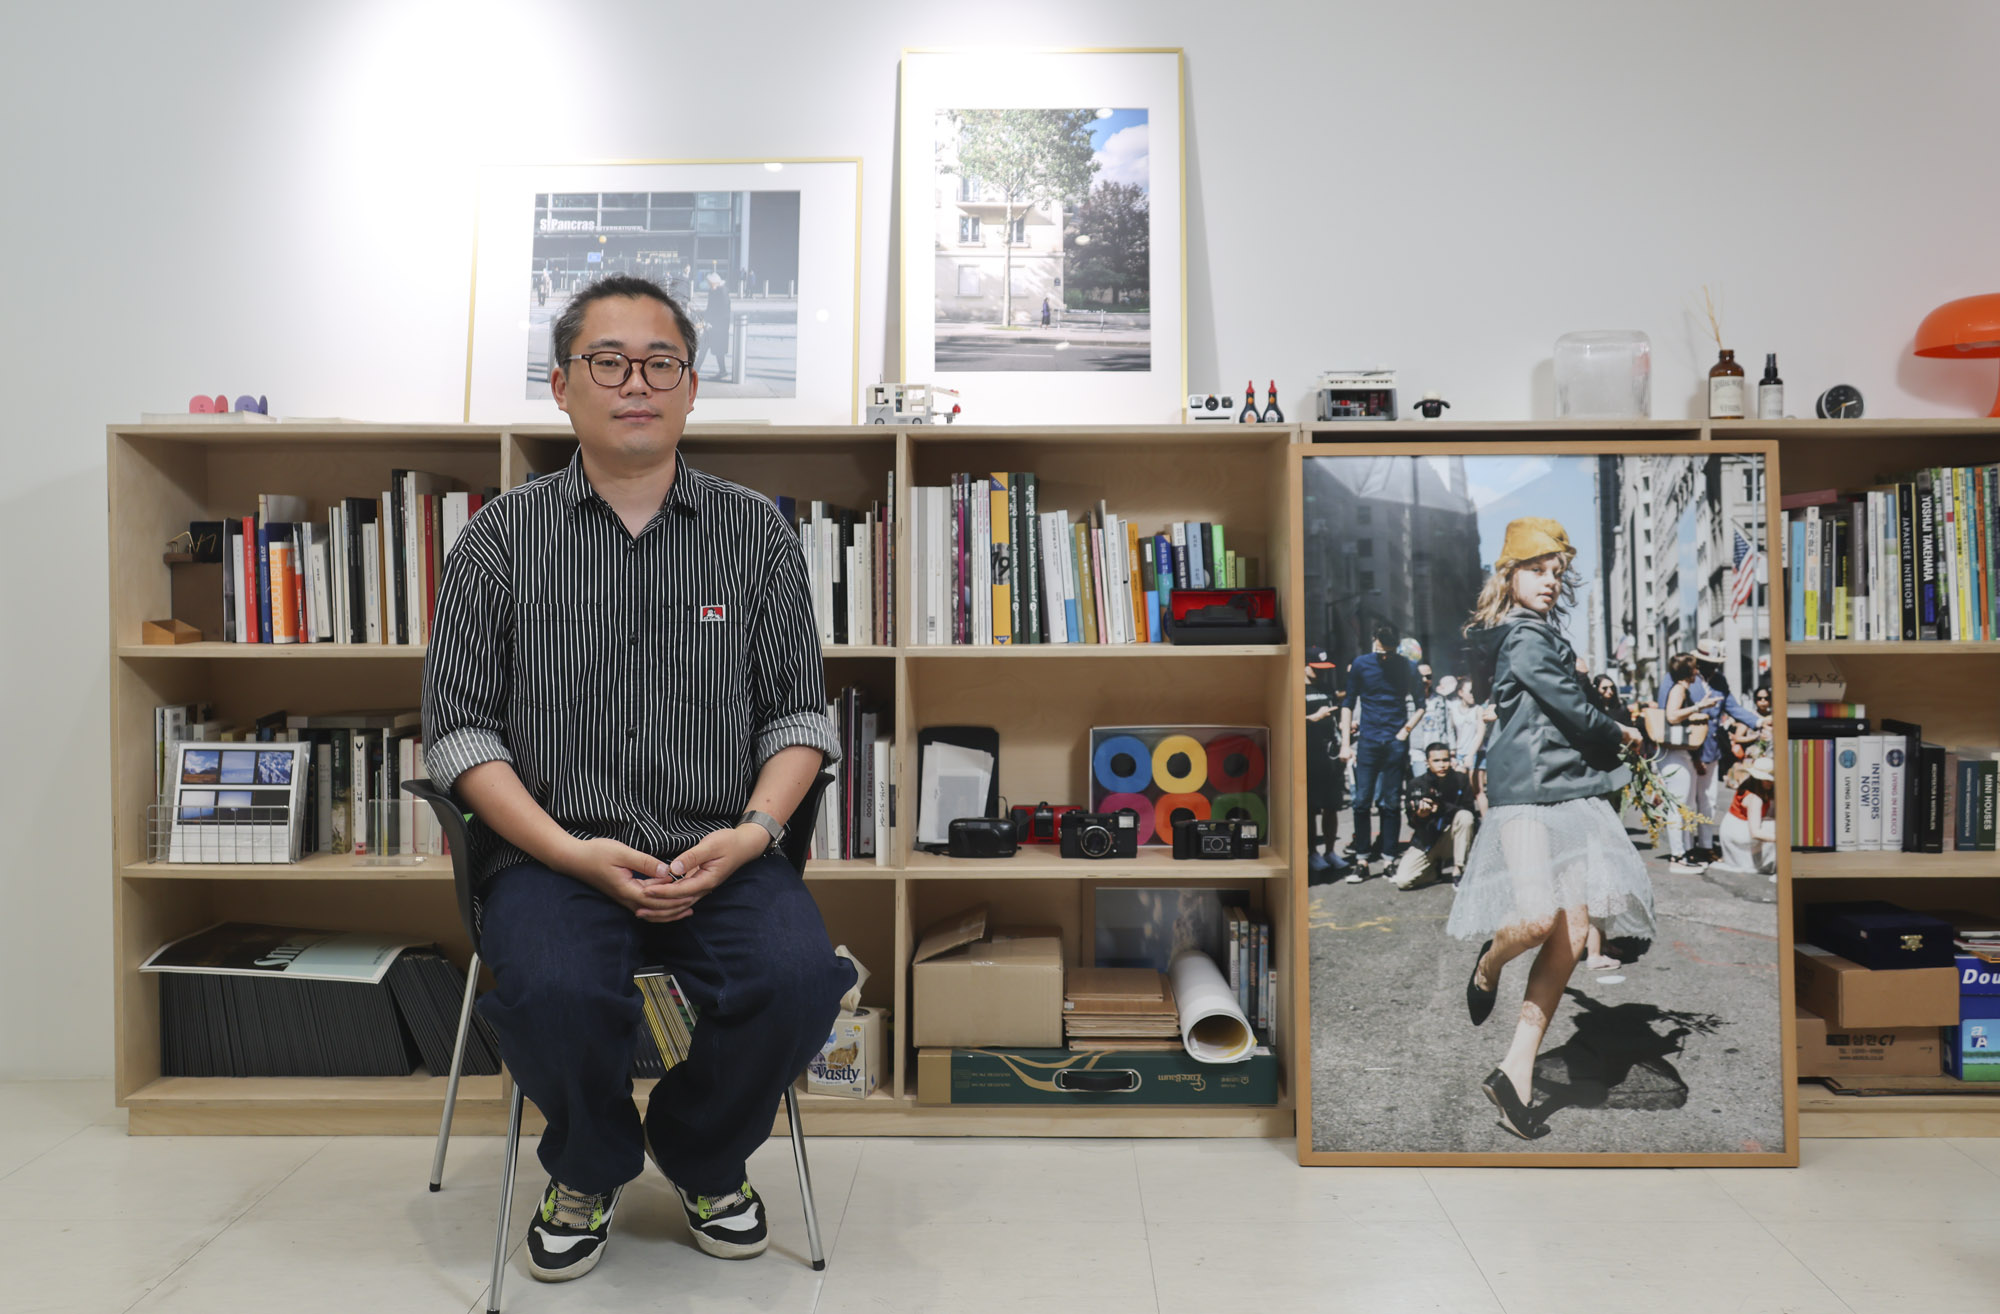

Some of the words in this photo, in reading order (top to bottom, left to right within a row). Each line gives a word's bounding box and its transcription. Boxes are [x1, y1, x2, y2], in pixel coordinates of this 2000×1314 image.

[551, 218, 595, 231] Pancras
[1921, 495, 1933, 532] YOSHIJI
[1901, 516, 1911, 560] JAPANESE
[1923, 534, 1934, 581] TAKEHARA
[1903, 563, 1913, 609] INTERIORS
[1860, 775, 1870, 807] NOW!
[1871, 763, 1880, 820] INTERIORS
[1984, 774, 1993, 794] MINI
[1844, 801, 1851, 810] IN
[1891, 797, 1898, 806] IN
[1983, 795, 1992, 831] HOUSES
[816, 1064, 861, 1084] Vastly
